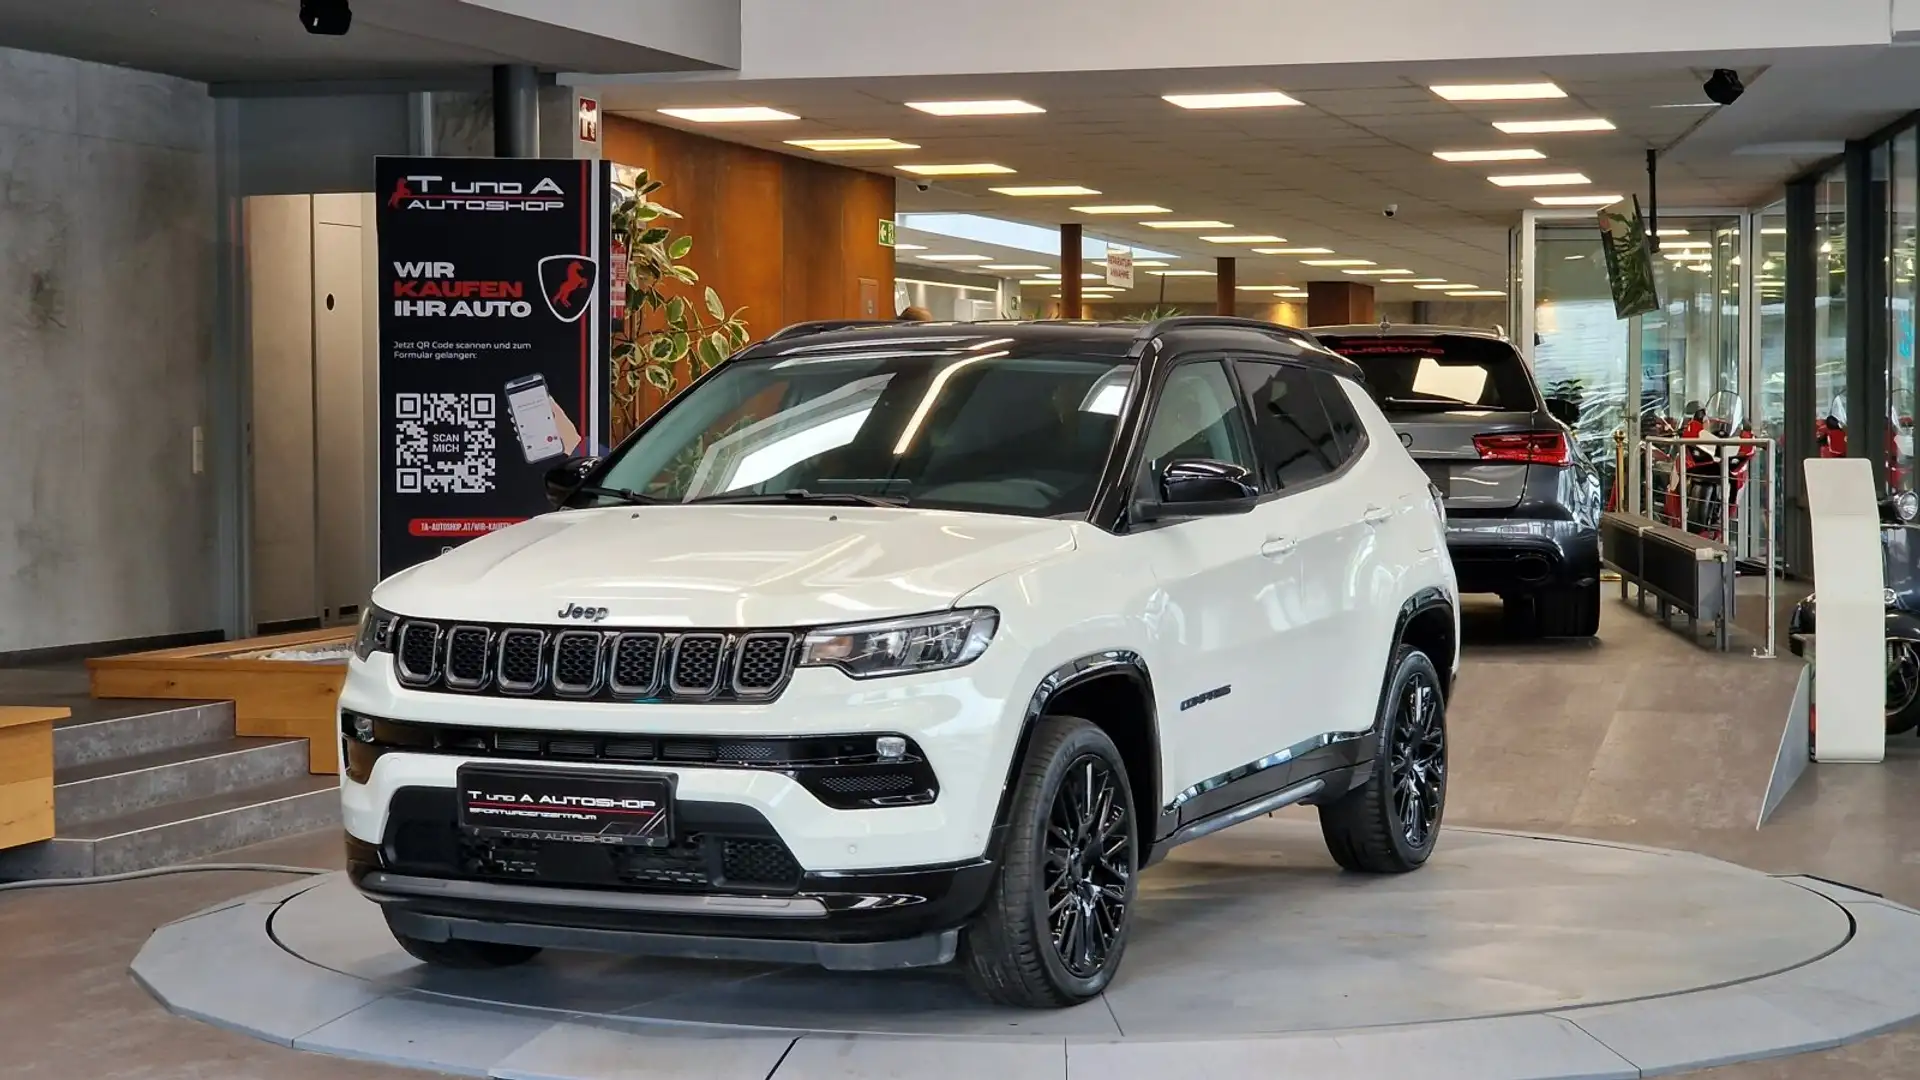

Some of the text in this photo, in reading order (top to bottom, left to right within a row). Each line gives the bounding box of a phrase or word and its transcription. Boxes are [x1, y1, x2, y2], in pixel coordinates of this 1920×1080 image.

[407, 175, 442, 193] T
[530, 177, 564, 195] A
[407, 200, 564, 212] AUTOSHOP
[394, 261, 455, 278] WIR
[394, 281, 523, 298] KAUFEN
[394, 300, 532, 317] IHR AUTO
[393, 341, 532, 350] Jetzt QR Code scannen und zum
[393, 351, 478, 361] Formular gelangen:
[432, 433, 460, 443] SCAN
[432, 443, 460, 453] MICH
[557, 602, 610, 623] Jeep
[467, 790, 482, 799] T
[520, 794, 534, 803] A
[539, 795, 656, 809] AUTOSHOP
[530, 832, 540, 840] A
[544, 833, 623, 844] AUTOSHOP
